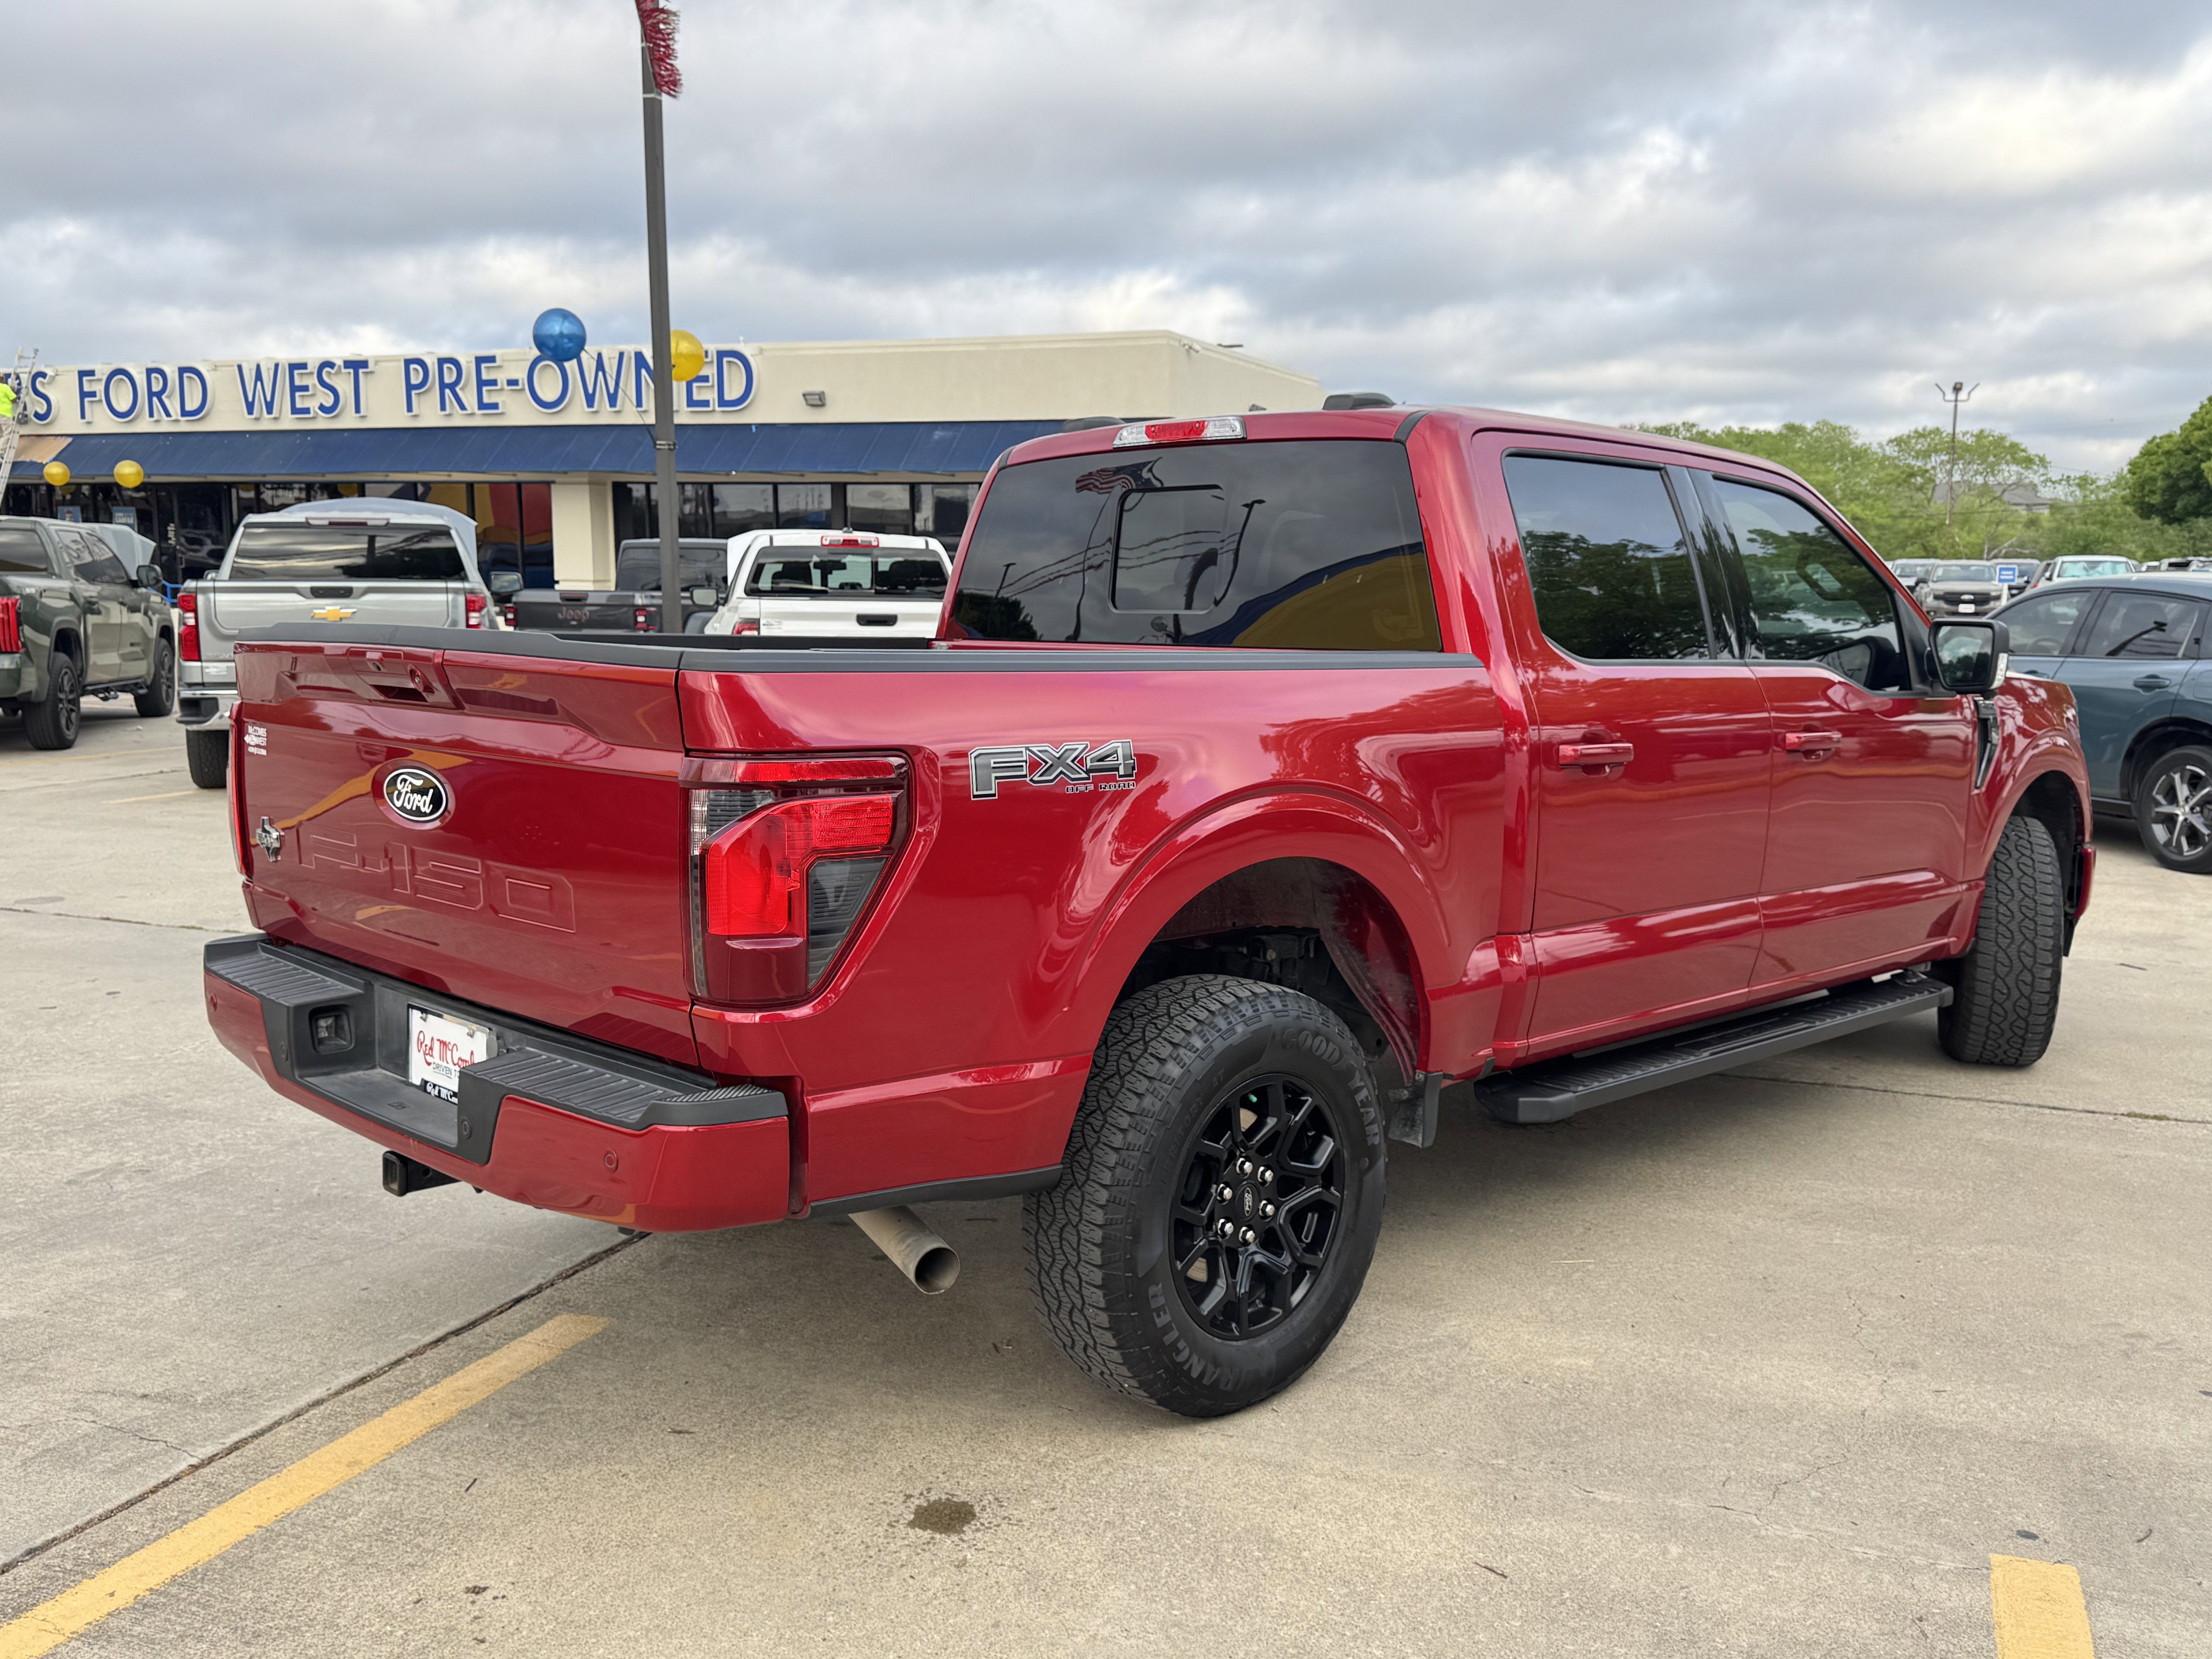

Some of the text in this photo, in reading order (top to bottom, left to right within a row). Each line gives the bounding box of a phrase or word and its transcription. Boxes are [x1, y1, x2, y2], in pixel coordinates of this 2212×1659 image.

[77, 366, 211, 421] FORD
[237, 359, 369, 417] WEST
[558, 606, 590, 623] Jeep
[969, 739, 1137, 800] FX4
[1065, 781, 1136, 793] OFF ROAD
[393, 775, 434, 813] Ford
[296, 821, 576, 933] F-150
[417, 1030, 434, 1066] Red
[433, 1061, 452, 1076] DRIVEN
